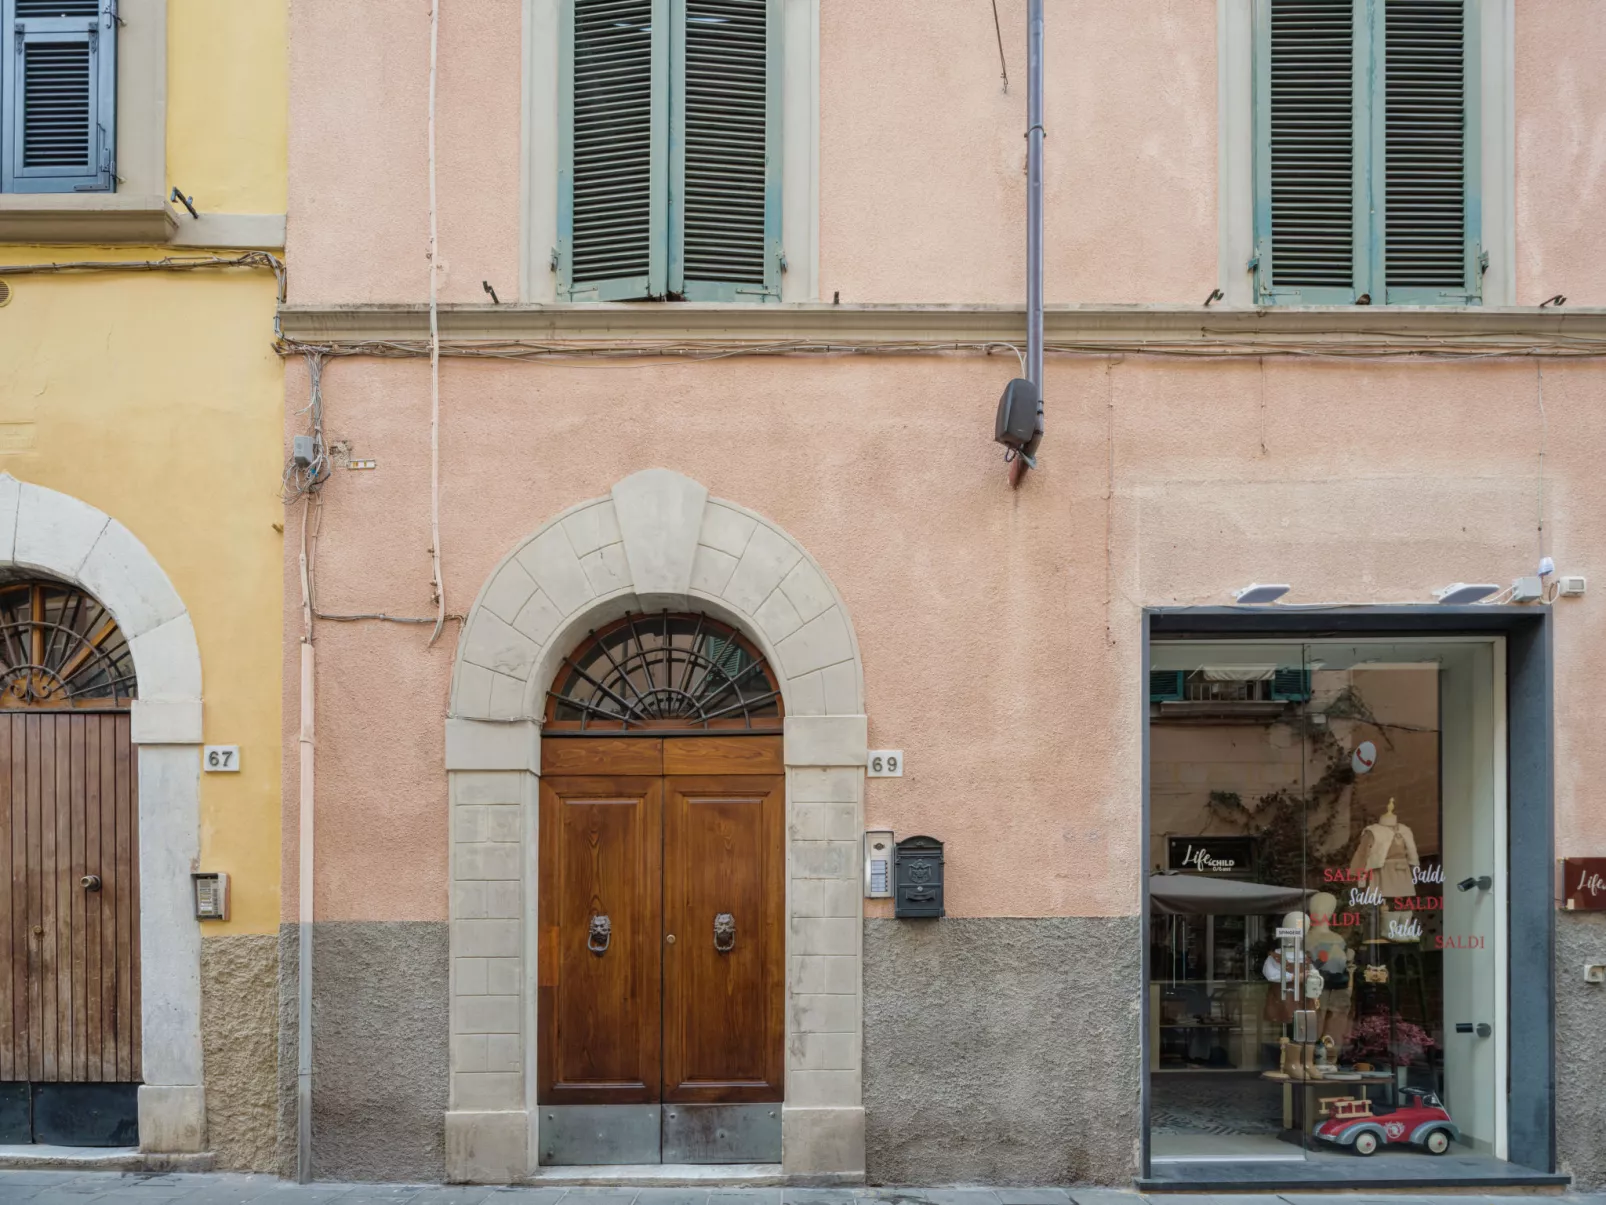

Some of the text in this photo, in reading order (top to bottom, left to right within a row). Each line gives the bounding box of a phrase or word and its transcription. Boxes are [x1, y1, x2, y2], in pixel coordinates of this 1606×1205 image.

[208, 750, 233, 767] 67
[872, 756, 898, 772] 69
[1182, 845, 1210, 871] Life
[1323, 867, 1374, 882] SALDI
[1411, 864, 1446, 885] Saldi
[1349, 886, 1384, 907] Saldi
[1394, 896, 1444, 911] SALDI
[1309, 912, 1361, 927] SALDI
[1388, 918, 1423, 940] Saldi
[1434, 935, 1485, 950] SALDI
